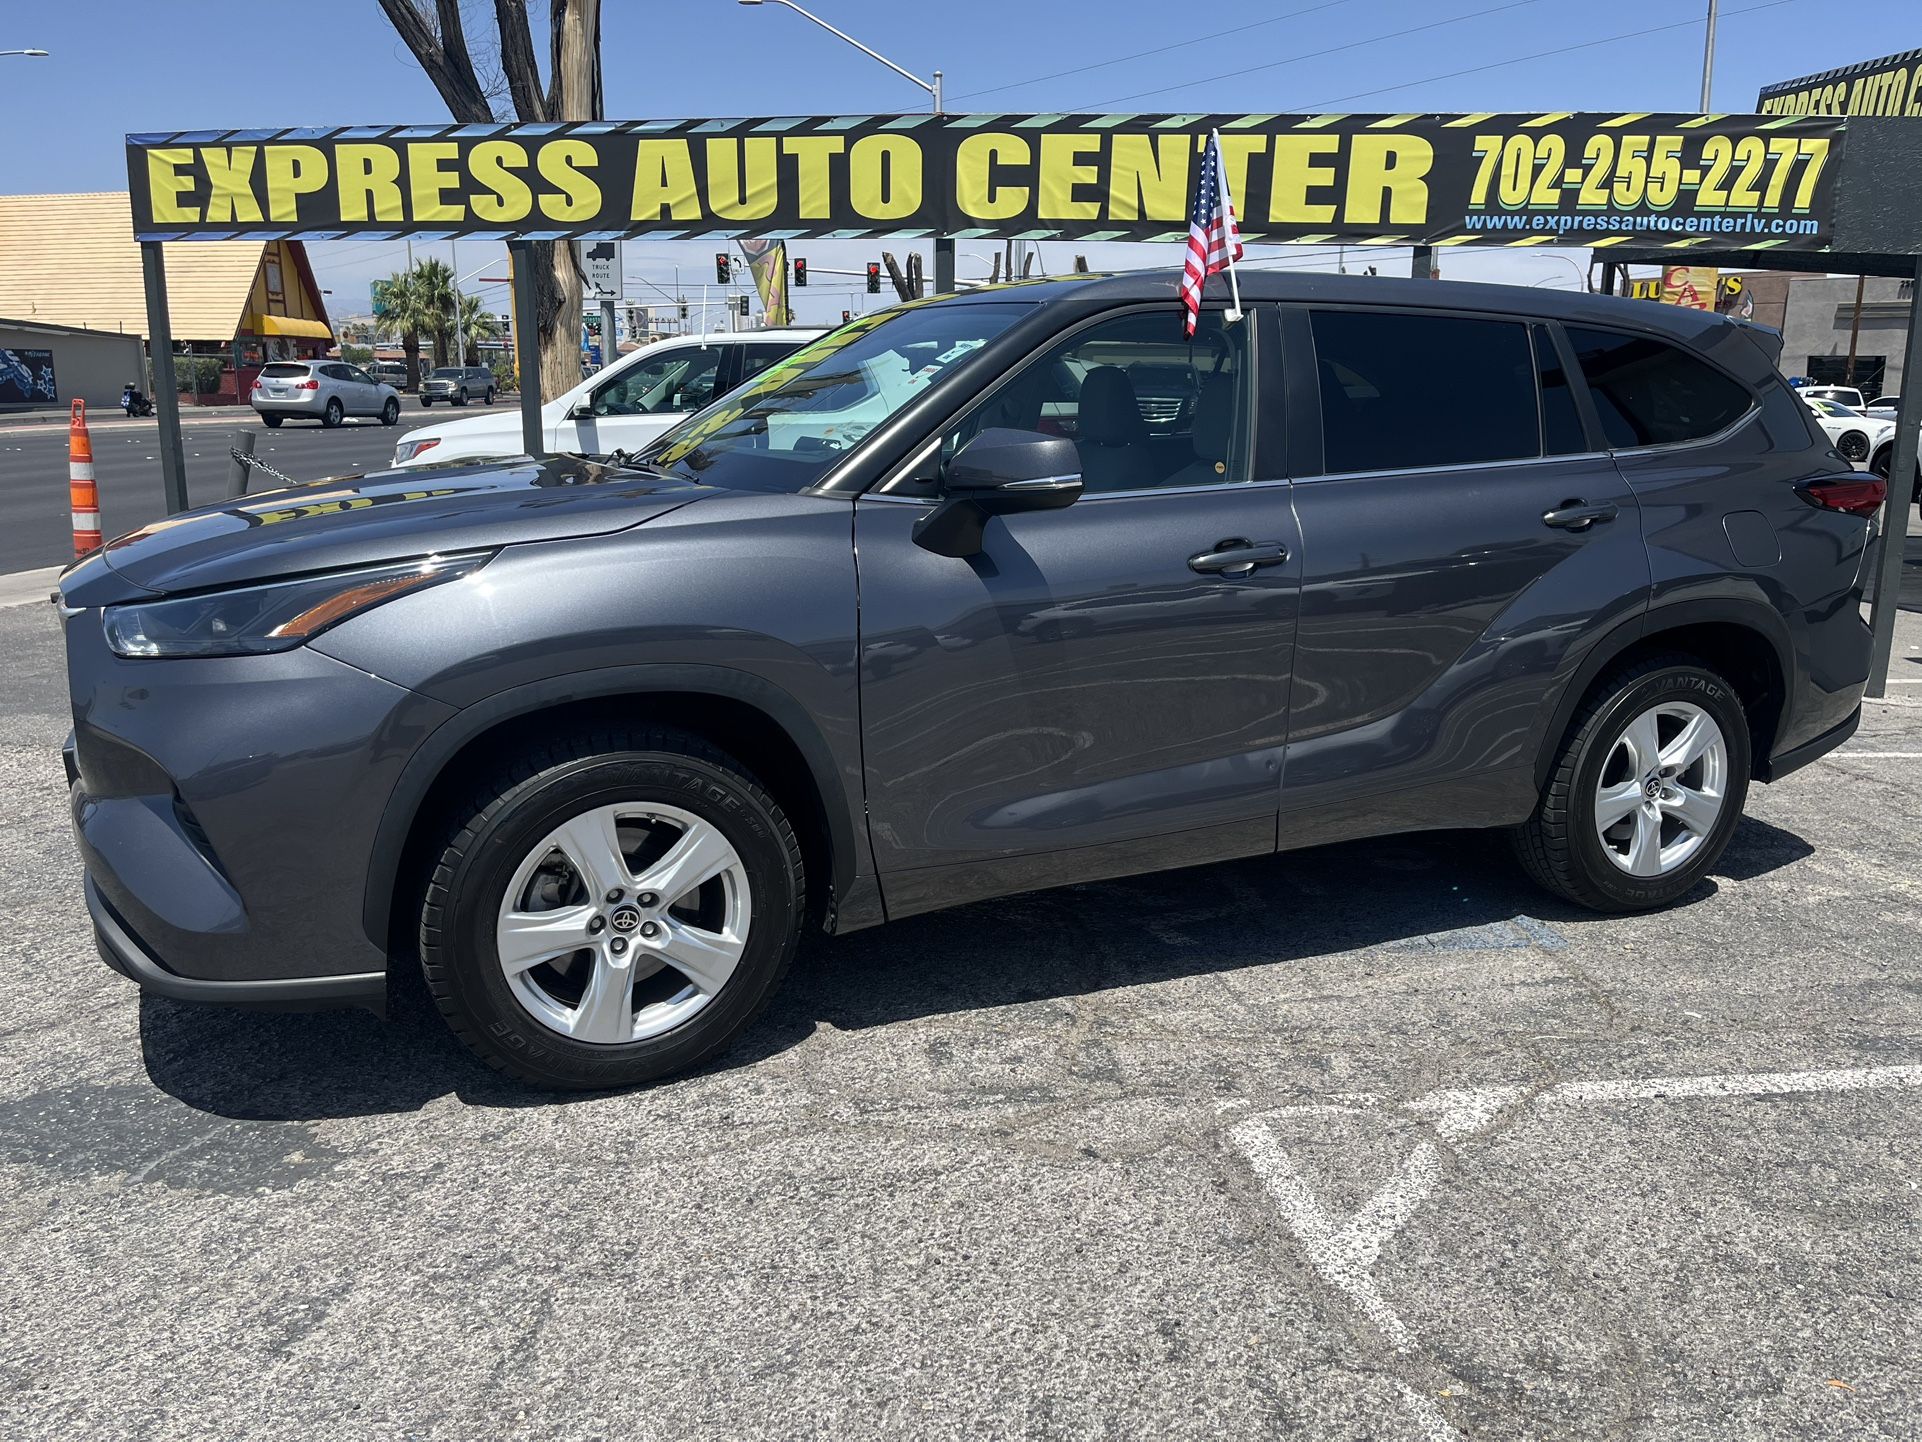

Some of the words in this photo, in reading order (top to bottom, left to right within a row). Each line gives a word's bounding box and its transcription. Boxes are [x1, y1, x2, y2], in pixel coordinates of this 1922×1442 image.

[147, 139, 603, 224] EXPRESS
[630, 133, 923, 221] AUTO
[955, 132, 1434, 225] CENTER
[1468, 133, 1830, 213] 702-255-2277
[1465, 212, 1820, 235] www.expressautocenterlv.com
